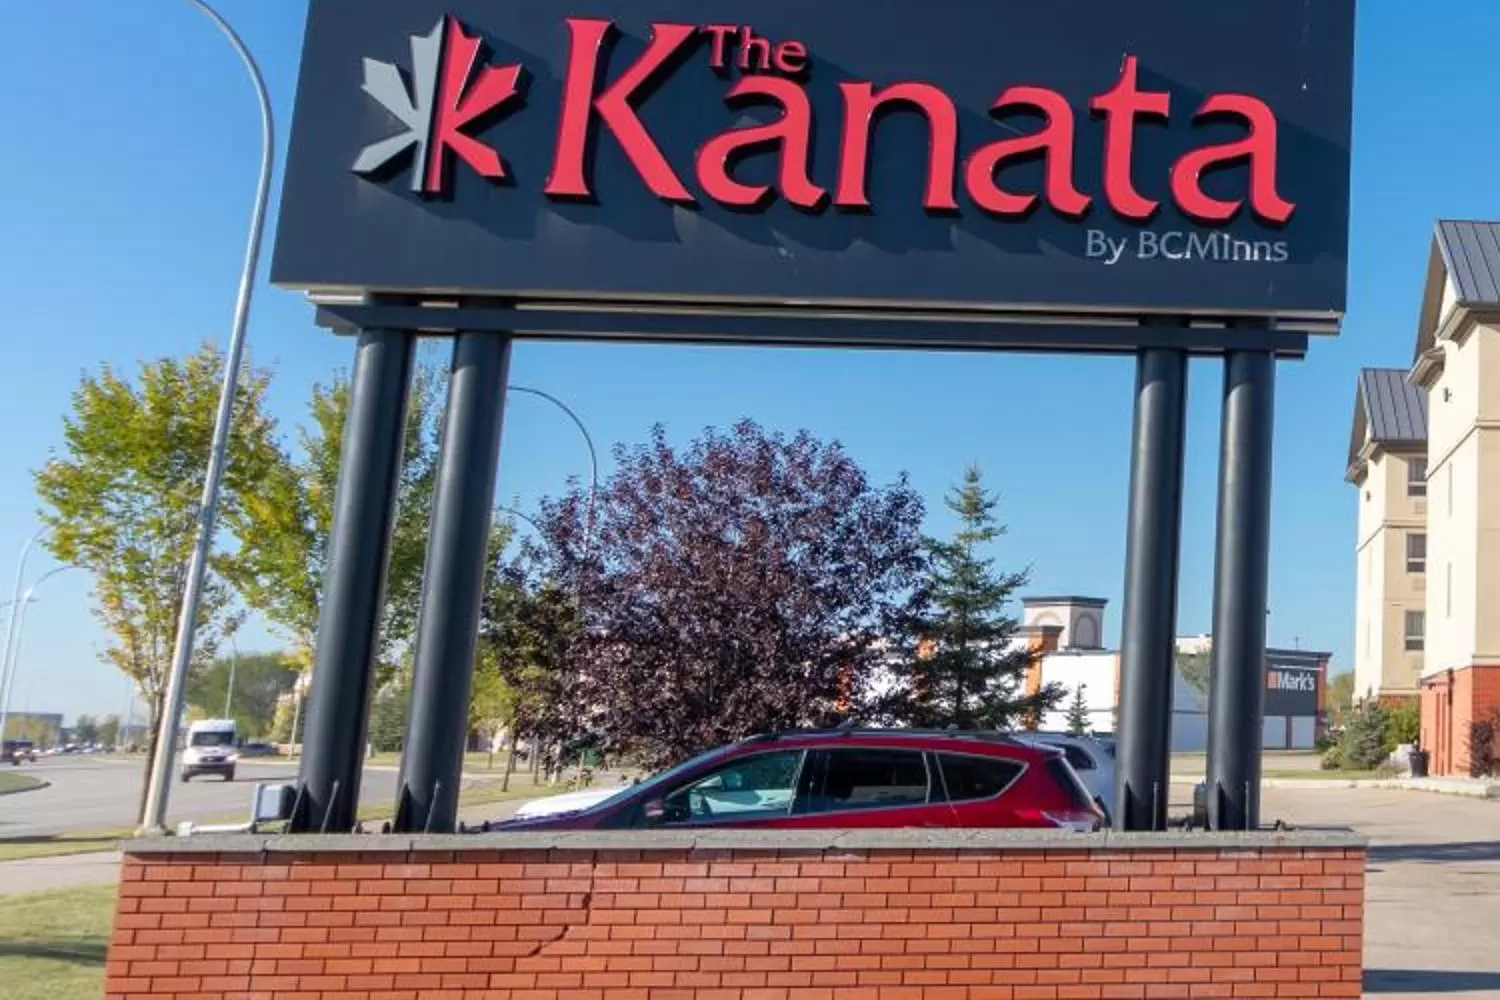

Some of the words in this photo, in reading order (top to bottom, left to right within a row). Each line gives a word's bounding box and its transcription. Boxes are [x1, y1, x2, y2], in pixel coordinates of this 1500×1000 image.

[703, 24, 808, 73] The
[543, 17, 1296, 223] Kanata
[1085, 229, 1128, 265] By
[1278, 671, 1315, 691] Mark's
